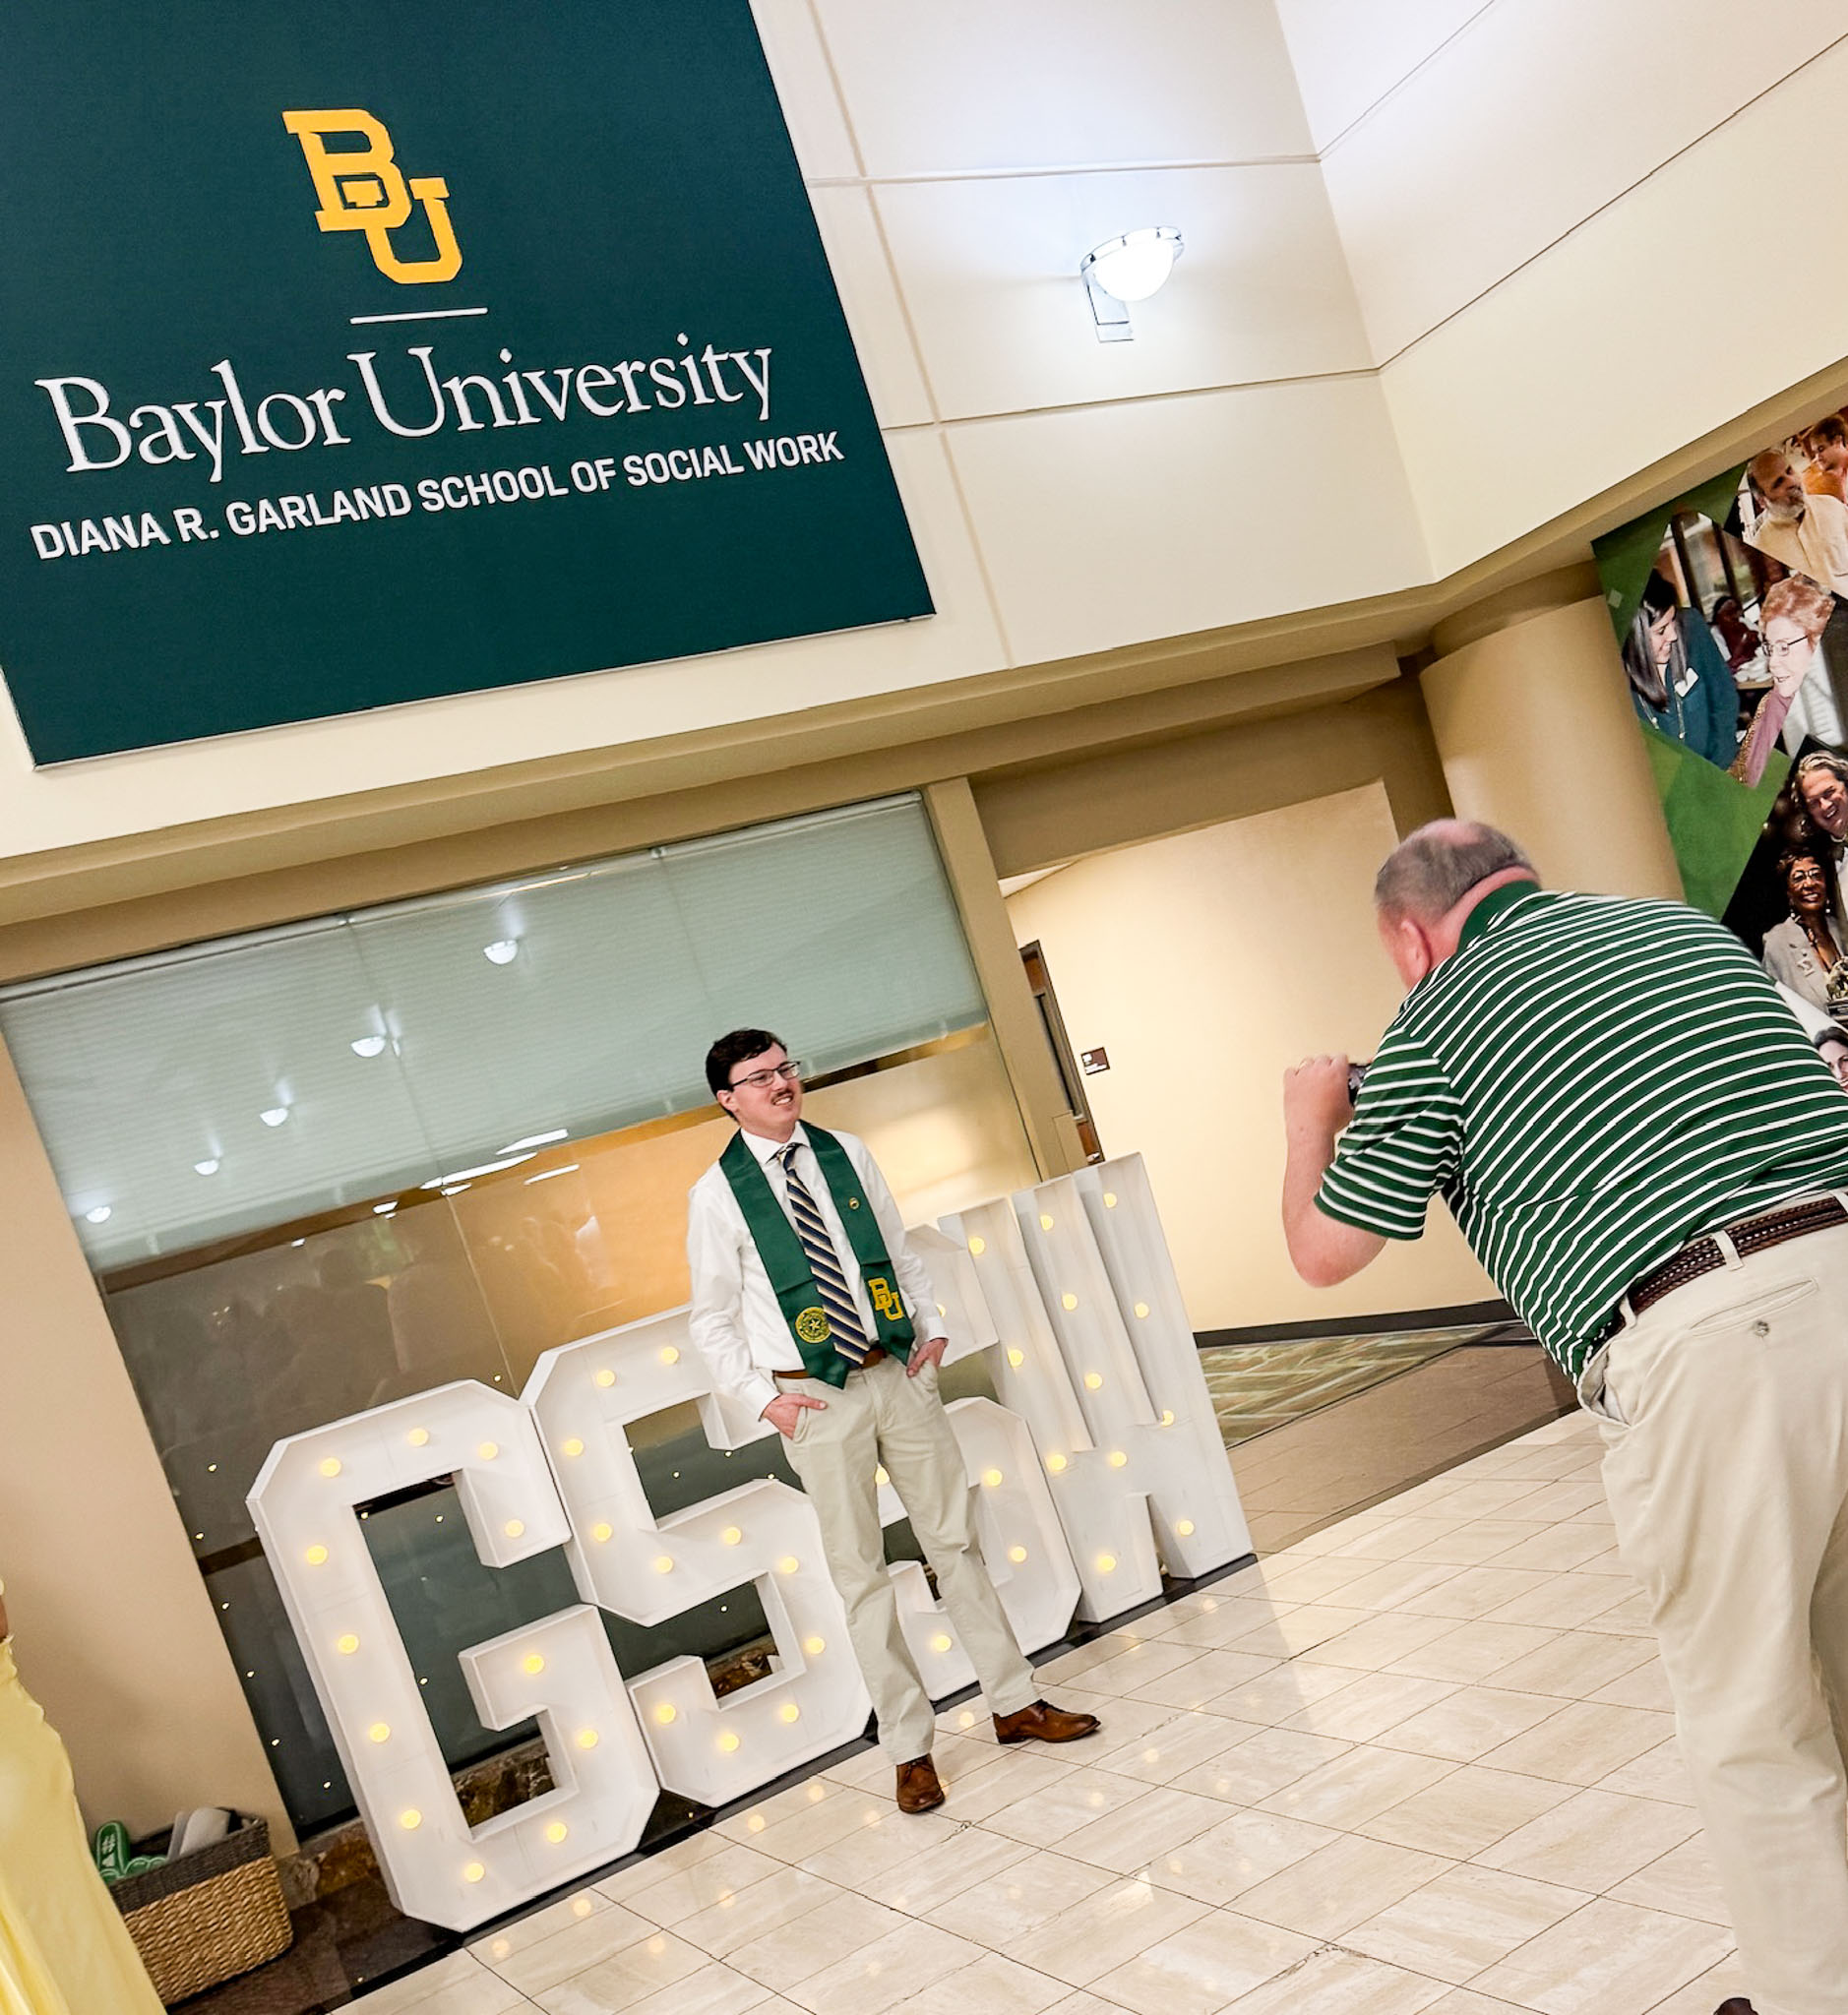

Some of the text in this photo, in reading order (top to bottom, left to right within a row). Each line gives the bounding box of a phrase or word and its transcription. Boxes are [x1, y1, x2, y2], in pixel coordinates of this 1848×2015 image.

[281, 108, 462, 284] BU
[34, 333, 772, 484] Baylor University
[30, 431, 845, 560] DIANA R. GARLAND SCHOOL OF SOCIAL WORK
[868, 1277, 904, 1320] BU
